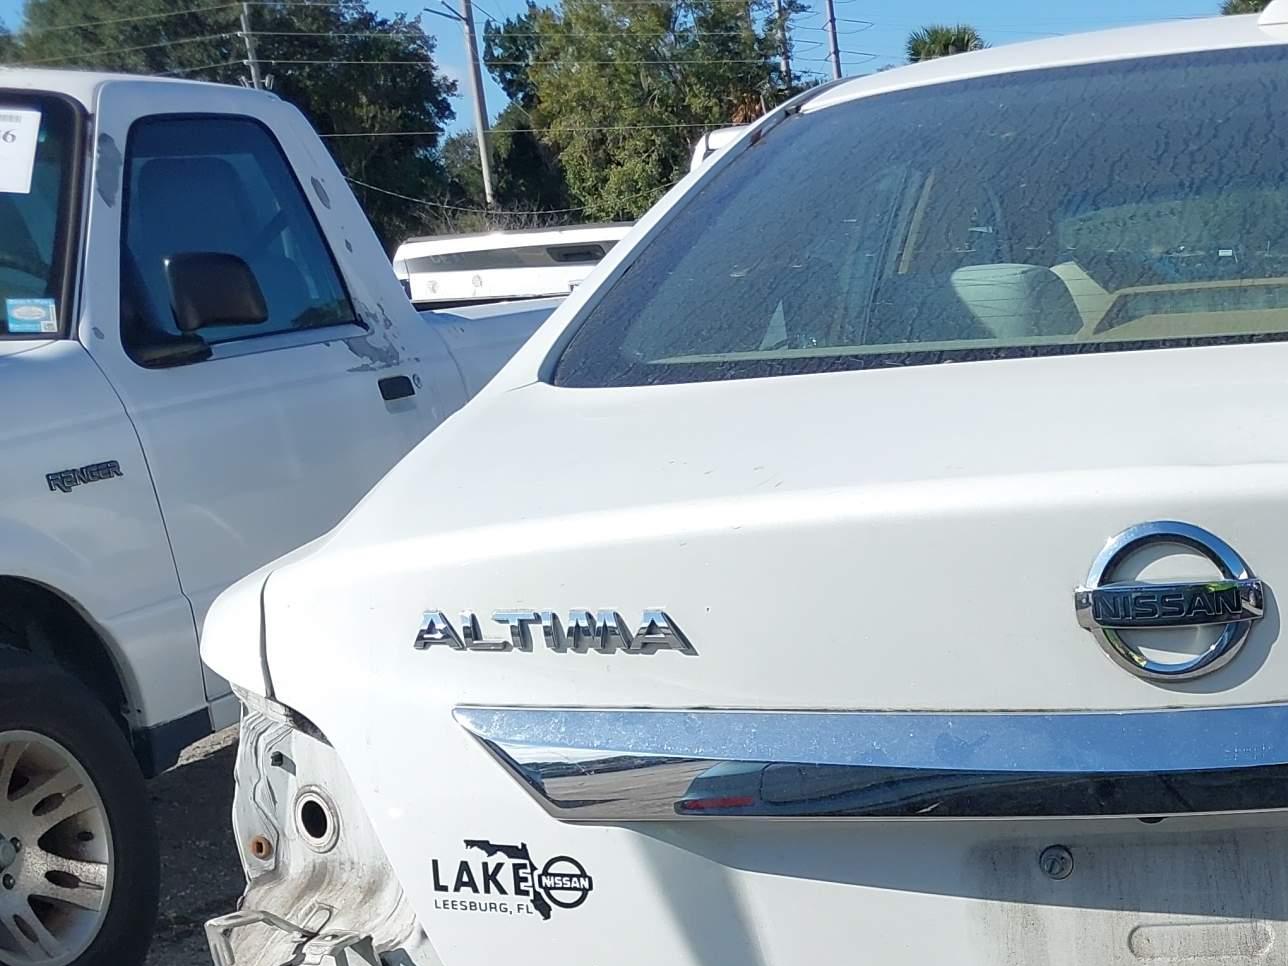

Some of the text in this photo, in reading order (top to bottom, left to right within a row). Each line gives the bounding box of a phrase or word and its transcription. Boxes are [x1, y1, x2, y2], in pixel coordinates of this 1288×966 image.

[1092, 588, 1244, 621] NISSAN
[413, 608, 699, 656] ALTIMA
[432, 859, 590, 897] LAKE NISSAN
[434, 899, 534, 915] LEESBURG, FL
